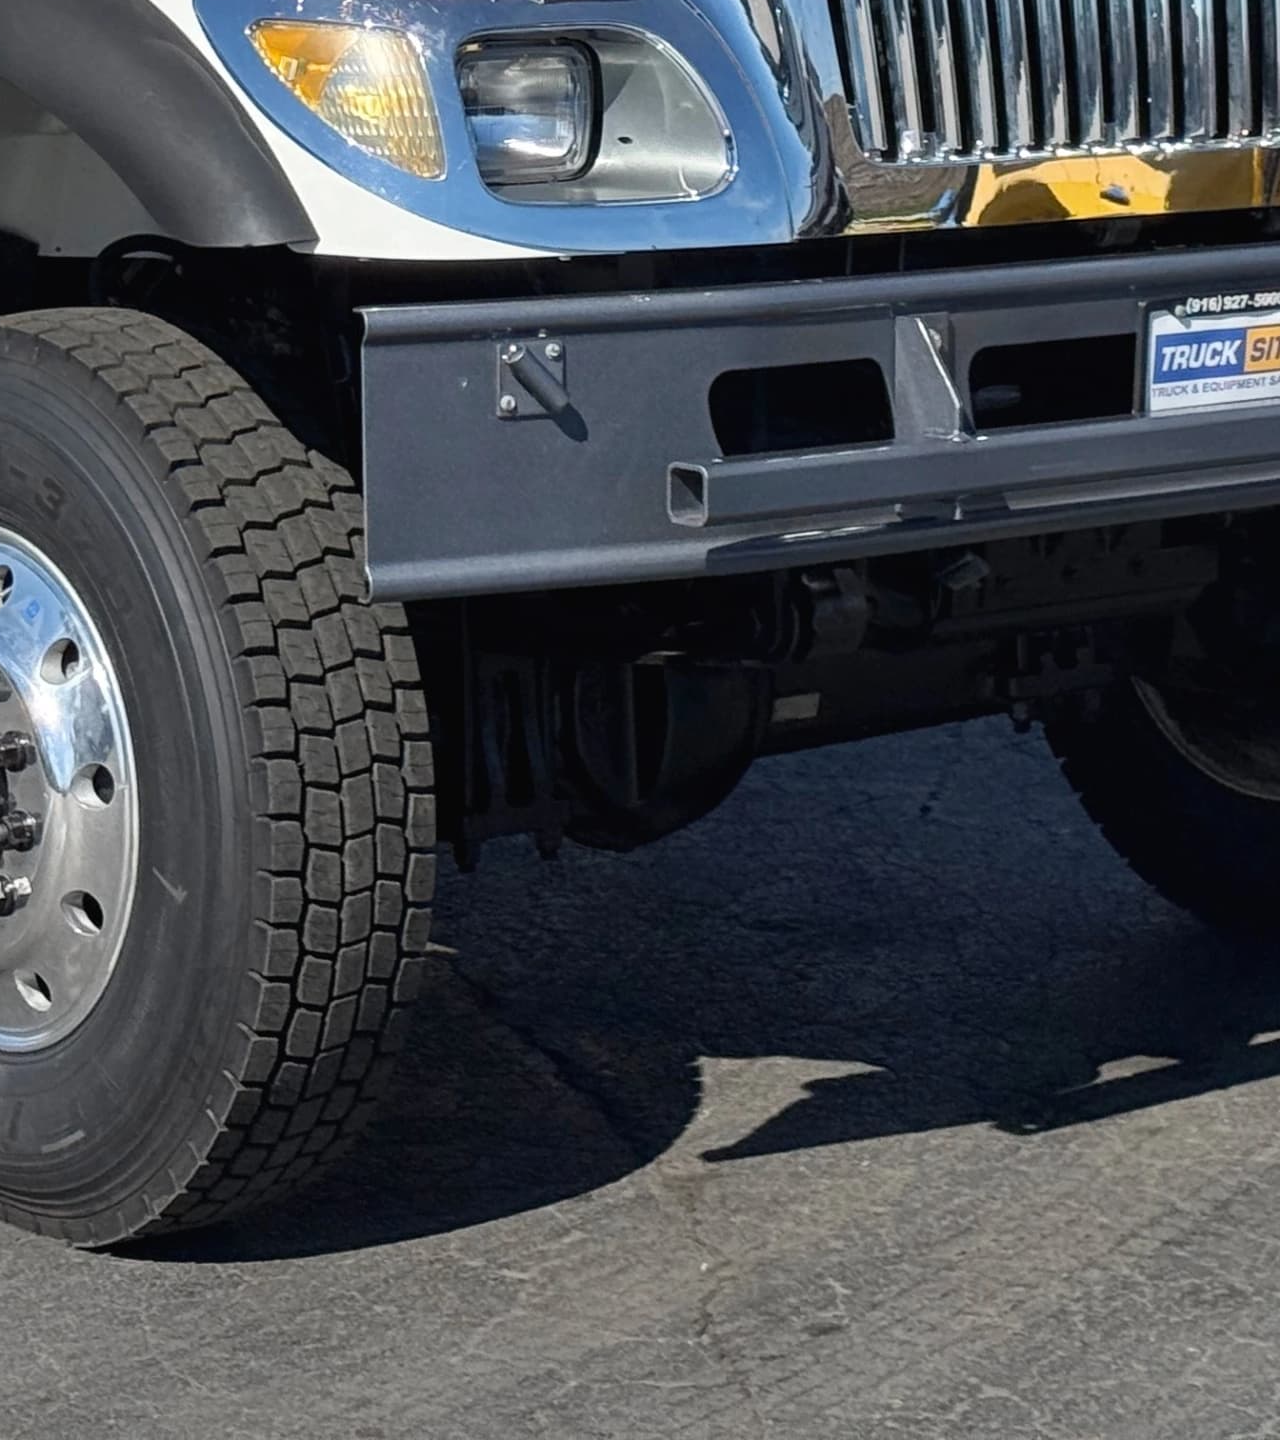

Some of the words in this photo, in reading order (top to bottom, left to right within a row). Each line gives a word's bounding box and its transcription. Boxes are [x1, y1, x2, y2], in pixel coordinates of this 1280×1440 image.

[1160, 339, 1242, 372] TRUCK
[1152, 385, 1188, 398] TRUCK
[1192, 383, 1199, 394] &
[1202, 377, 1266, 393] EQUIPMENT
